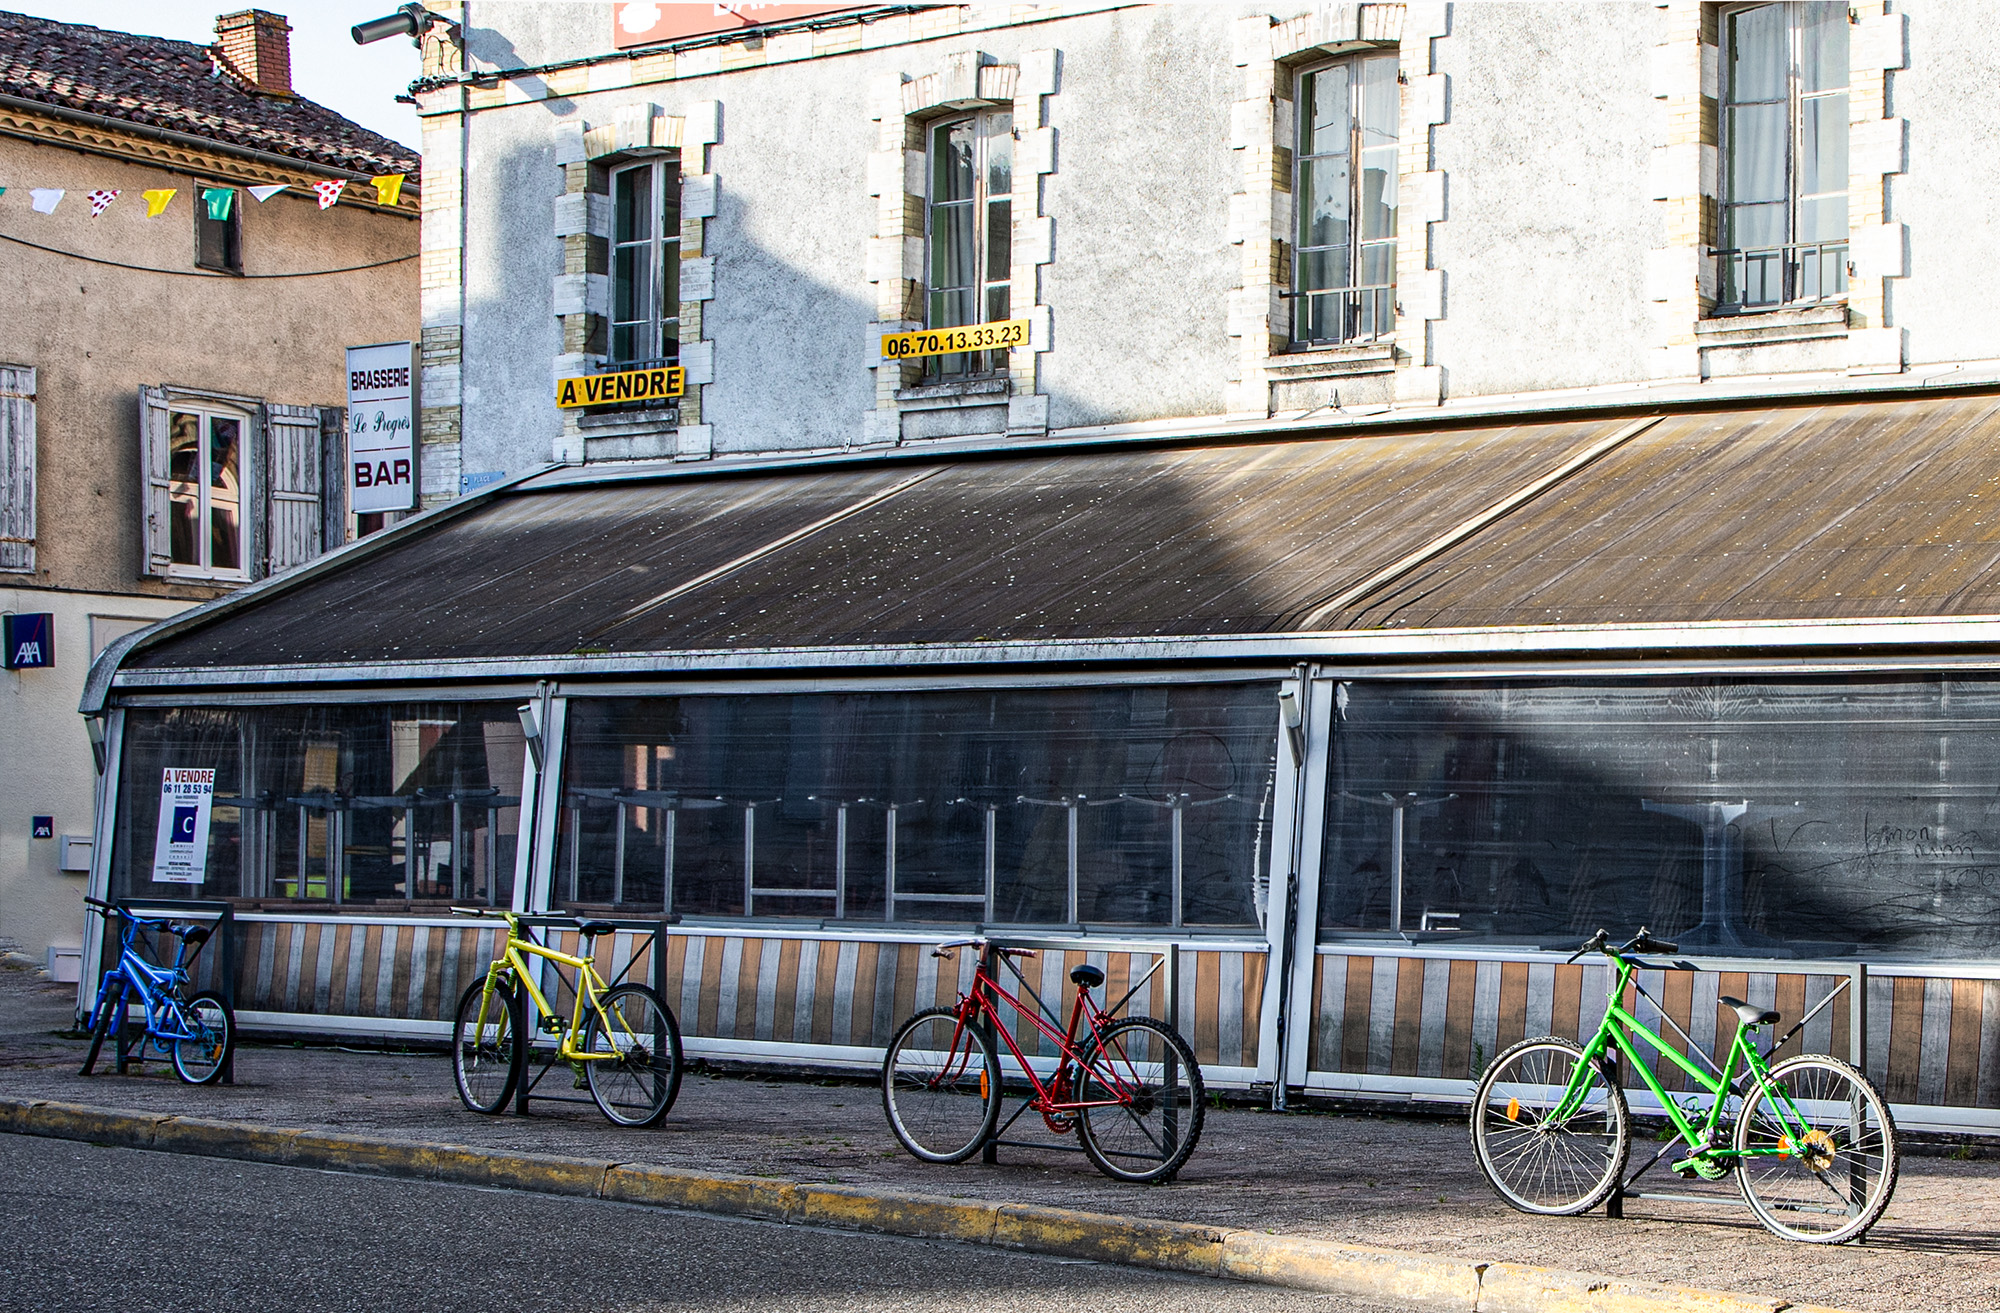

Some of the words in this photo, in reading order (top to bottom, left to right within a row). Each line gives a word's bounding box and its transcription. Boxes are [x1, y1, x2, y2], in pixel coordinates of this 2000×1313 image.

[888, 325, 1022, 356] 06.70.13.33.23
[351, 367, 409, 391] BRASSERIE
[560, 381, 577, 405] A
[584, 369, 681, 402] VENDRE
[352, 412, 367, 434] Le
[373, 410, 410, 440] Progrès
[354, 458, 411, 488] BAR
[14, 641, 42, 664] AXA
[164, 770, 171, 783] A
[174, 770, 214, 783] VENDRE
[163, 784, 172, 794] 06
[173, 784, 181, 794] 11
[182, 784, 192, 794] 28
[192, 784, 202, 794] 53
[203, 785, 212, 795] 94
[34, 826, 50, 836] AXA
